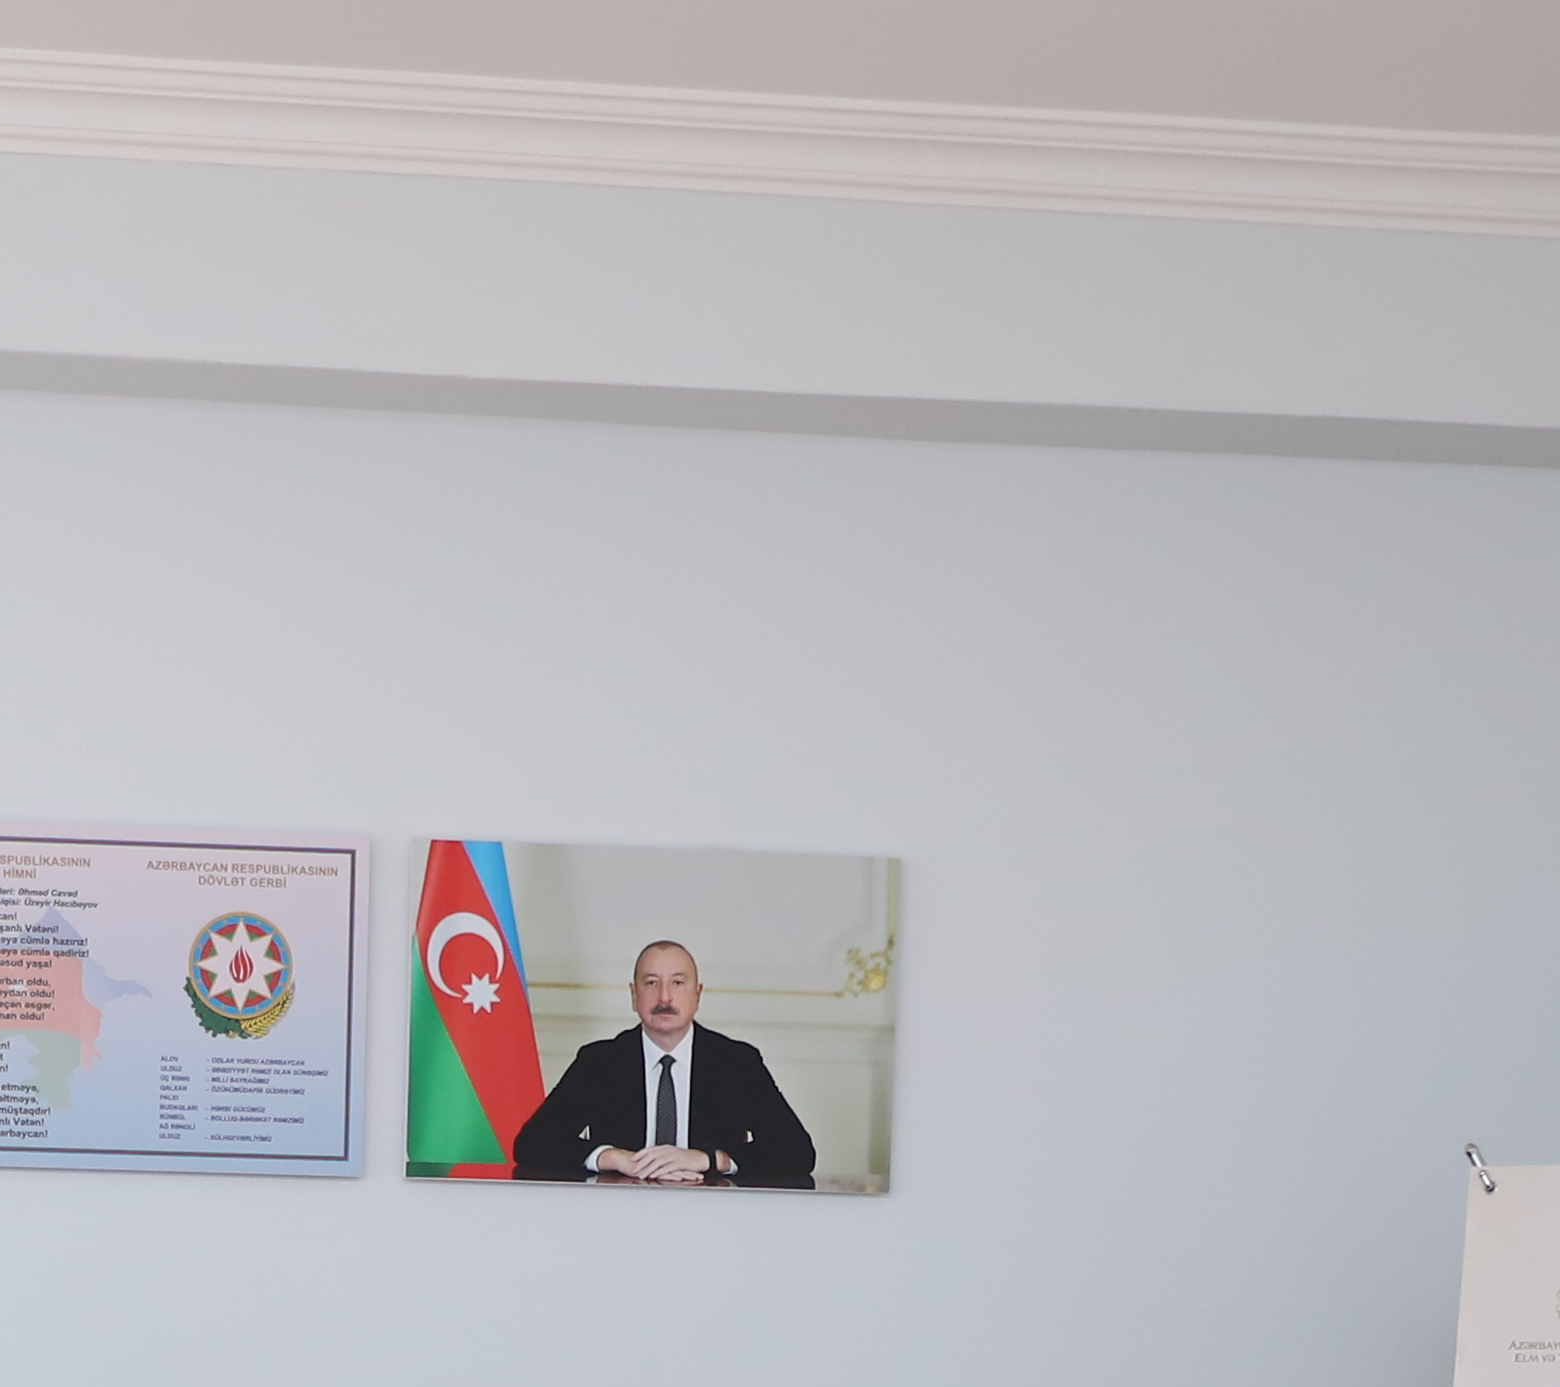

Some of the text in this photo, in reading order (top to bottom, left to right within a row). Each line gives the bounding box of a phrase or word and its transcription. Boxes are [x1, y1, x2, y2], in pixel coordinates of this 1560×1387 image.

[147, 861, 338, 876] AZƏRBAYCAN RESPUBLİKASININ
[3, 868, 36, 879] HİMNİ
[198, 875, 287, 888] DÖVLƏT GERBİ
[52, 889, 78, 898] Cavad
[0, 923, 22, 934] şanlı
[20, 936, 50, 945] cümlə
[21, 947, 50, 956] cümlə
[26, 960, 52, 969] yaşa!
[27, 978, 51, 988] oldu,
[30, 989, 54, 998] oldu!
[25, 1003, 54, 1012] əsgər,
[20, 1012, 44, 1021] oldu!
[2, 1083, 39, 1093] etməyə,
[13, 1118, 44, 1127] Vətən!
[1514, 1353, 1539, 1362] ELM
